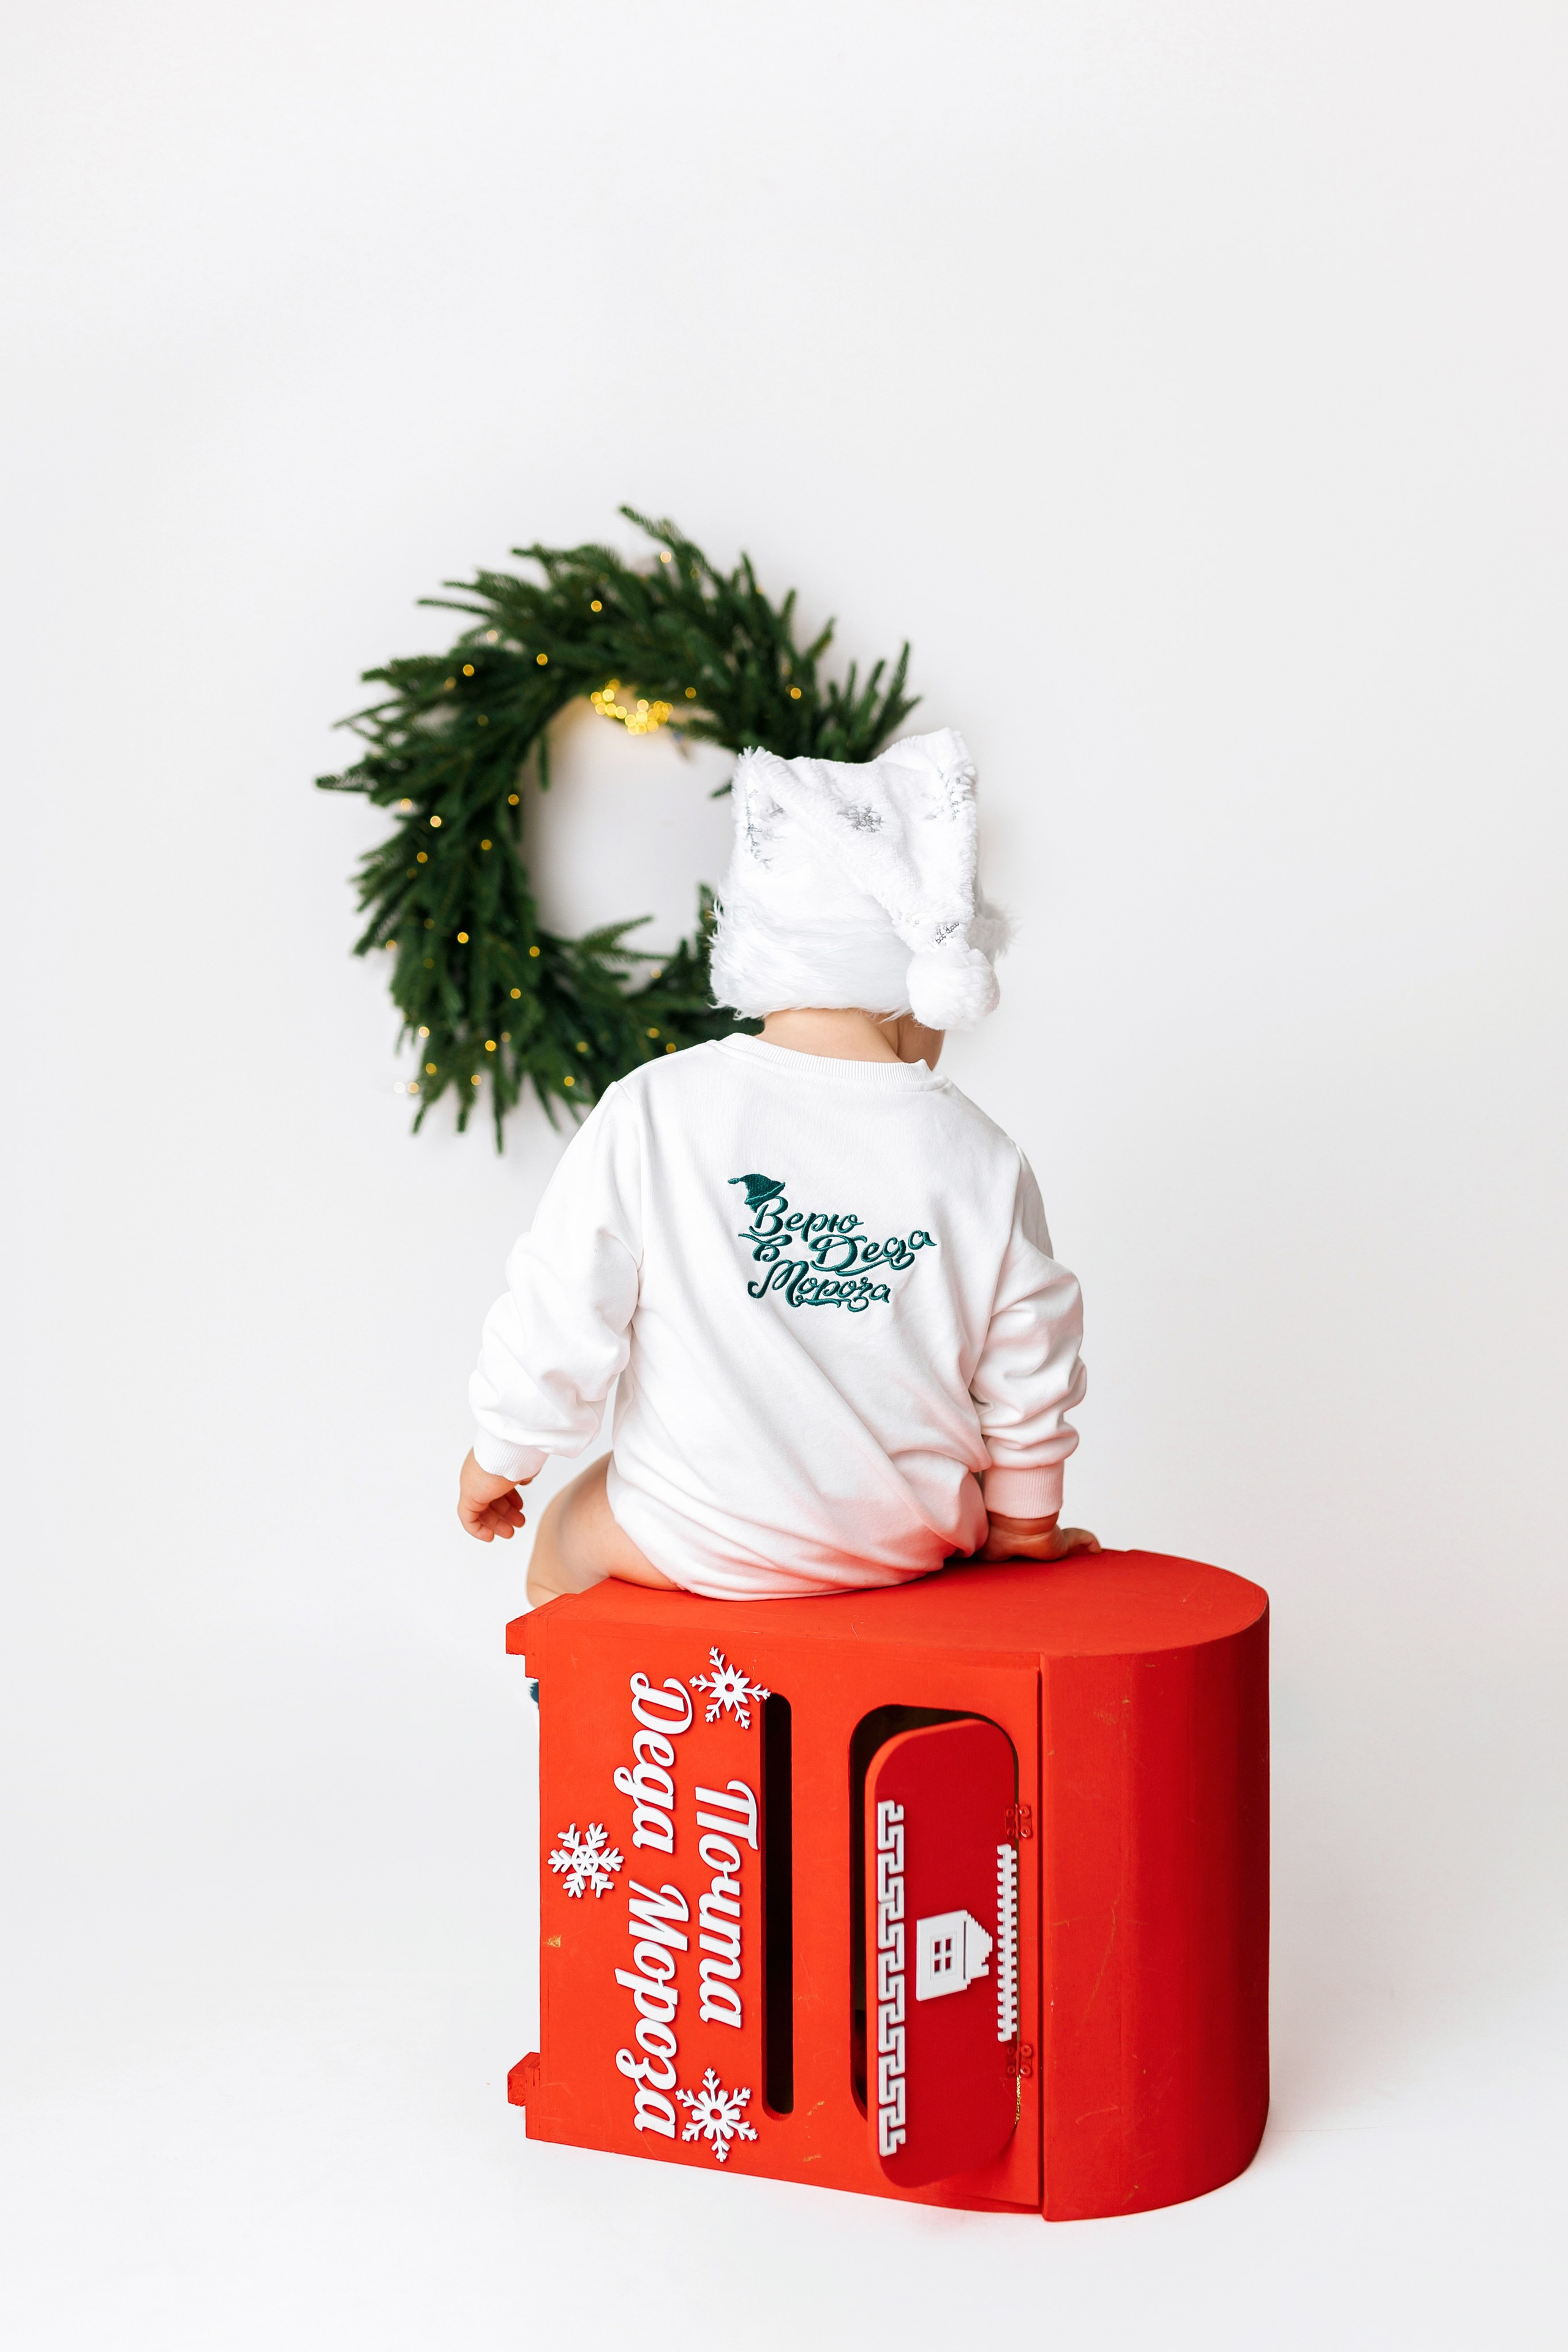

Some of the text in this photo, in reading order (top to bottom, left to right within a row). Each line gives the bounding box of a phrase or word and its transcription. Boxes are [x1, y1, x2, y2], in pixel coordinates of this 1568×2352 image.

[748, 1196, 864, 1242] Верю
[808, 1230, 937, 1277] Деда
[747, 1259, 891, 1313] Мороза
[613, 1672, 693, 2139] Деда Мороза
[695, 1780, 758, 2029] Почта
